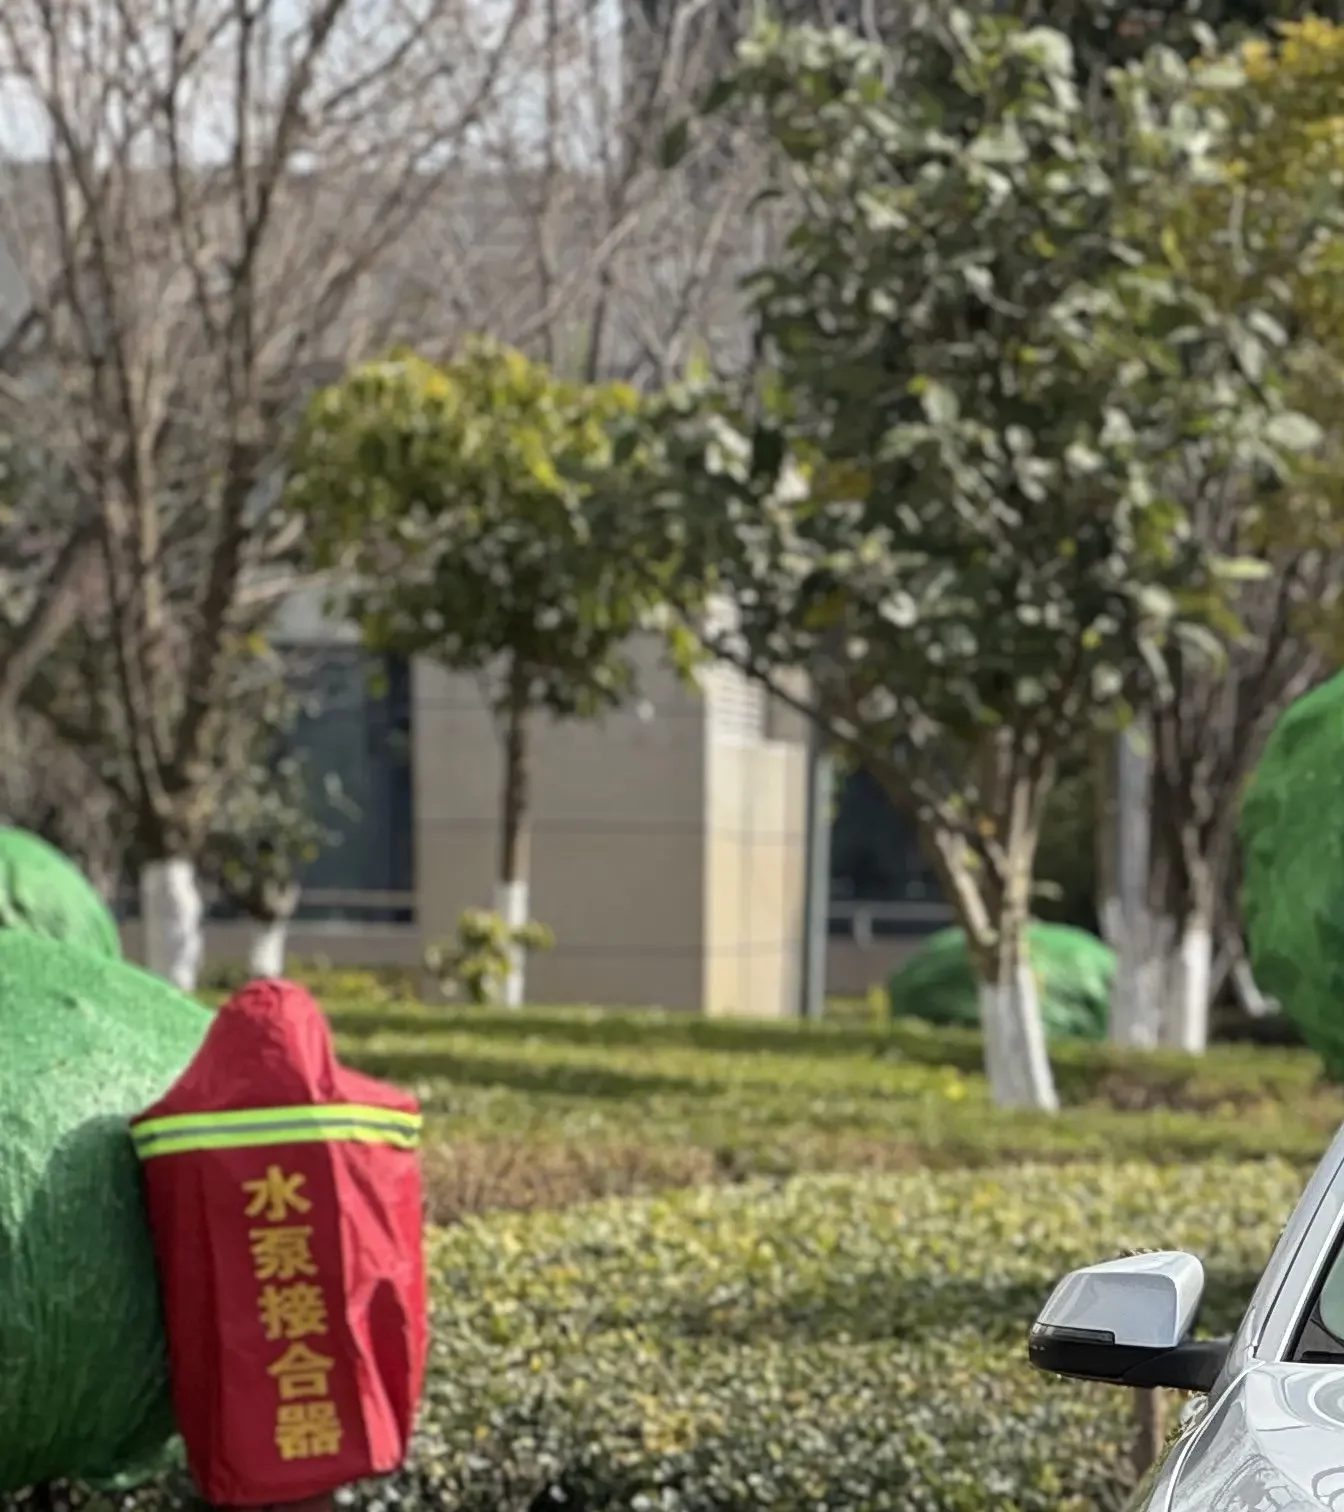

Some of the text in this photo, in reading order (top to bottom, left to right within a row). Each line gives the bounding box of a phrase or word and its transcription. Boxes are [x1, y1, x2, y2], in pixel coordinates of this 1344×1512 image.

[242, 1164, 342, 1461] 水泵接合器
